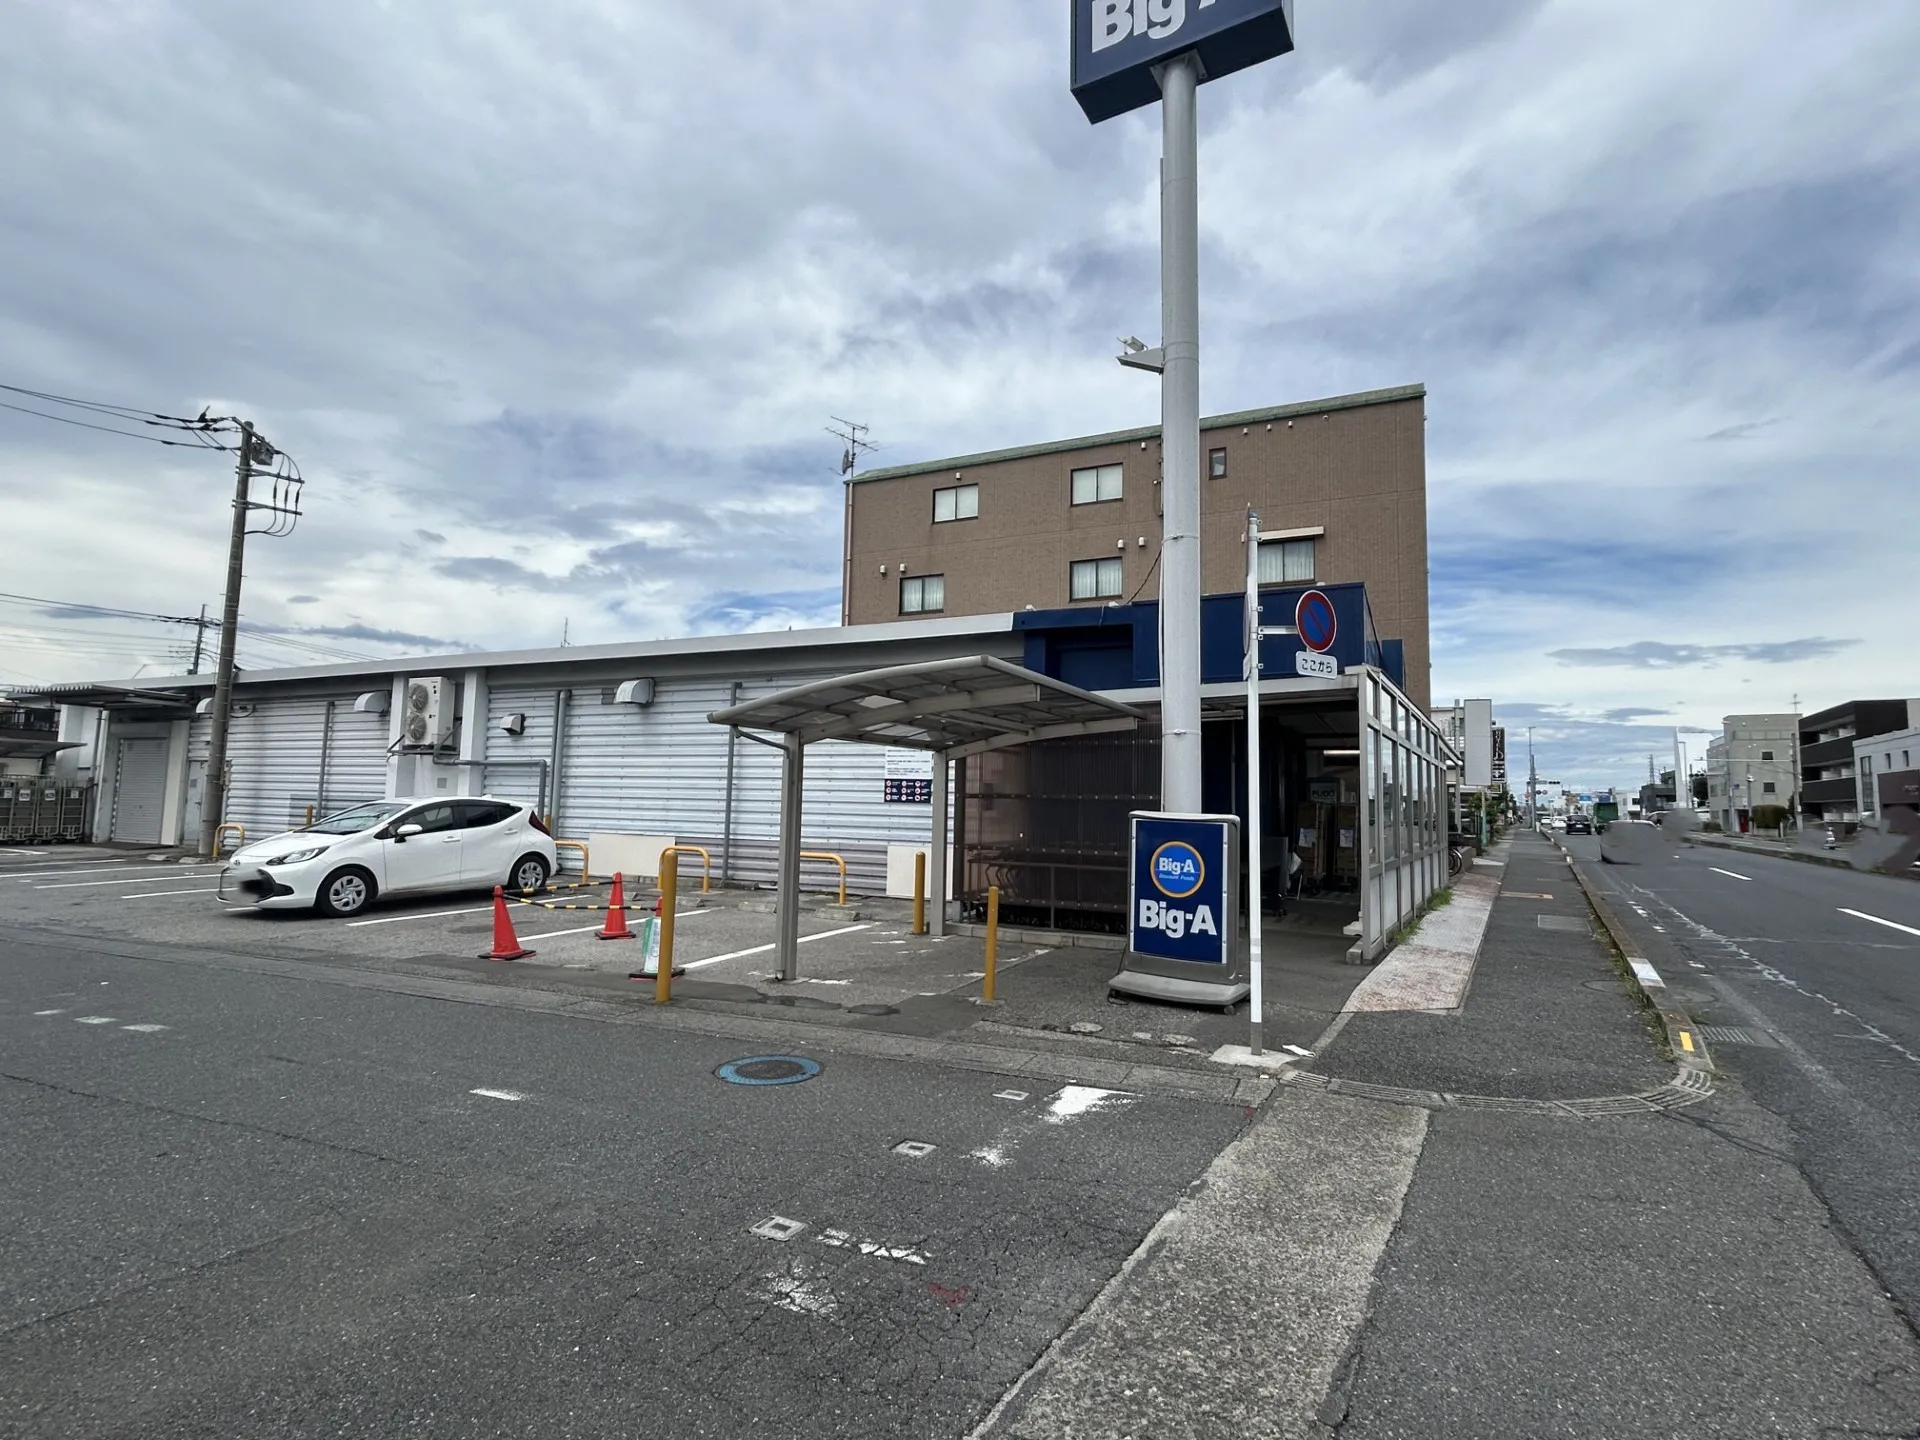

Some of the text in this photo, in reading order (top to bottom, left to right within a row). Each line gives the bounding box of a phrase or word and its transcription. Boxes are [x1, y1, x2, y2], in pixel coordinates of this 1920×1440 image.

[1301, 658, 1333, 674] ここから
[1159, 857, 1195, 875] Big-A
[1139, 899, 1217, 938] Big-A
